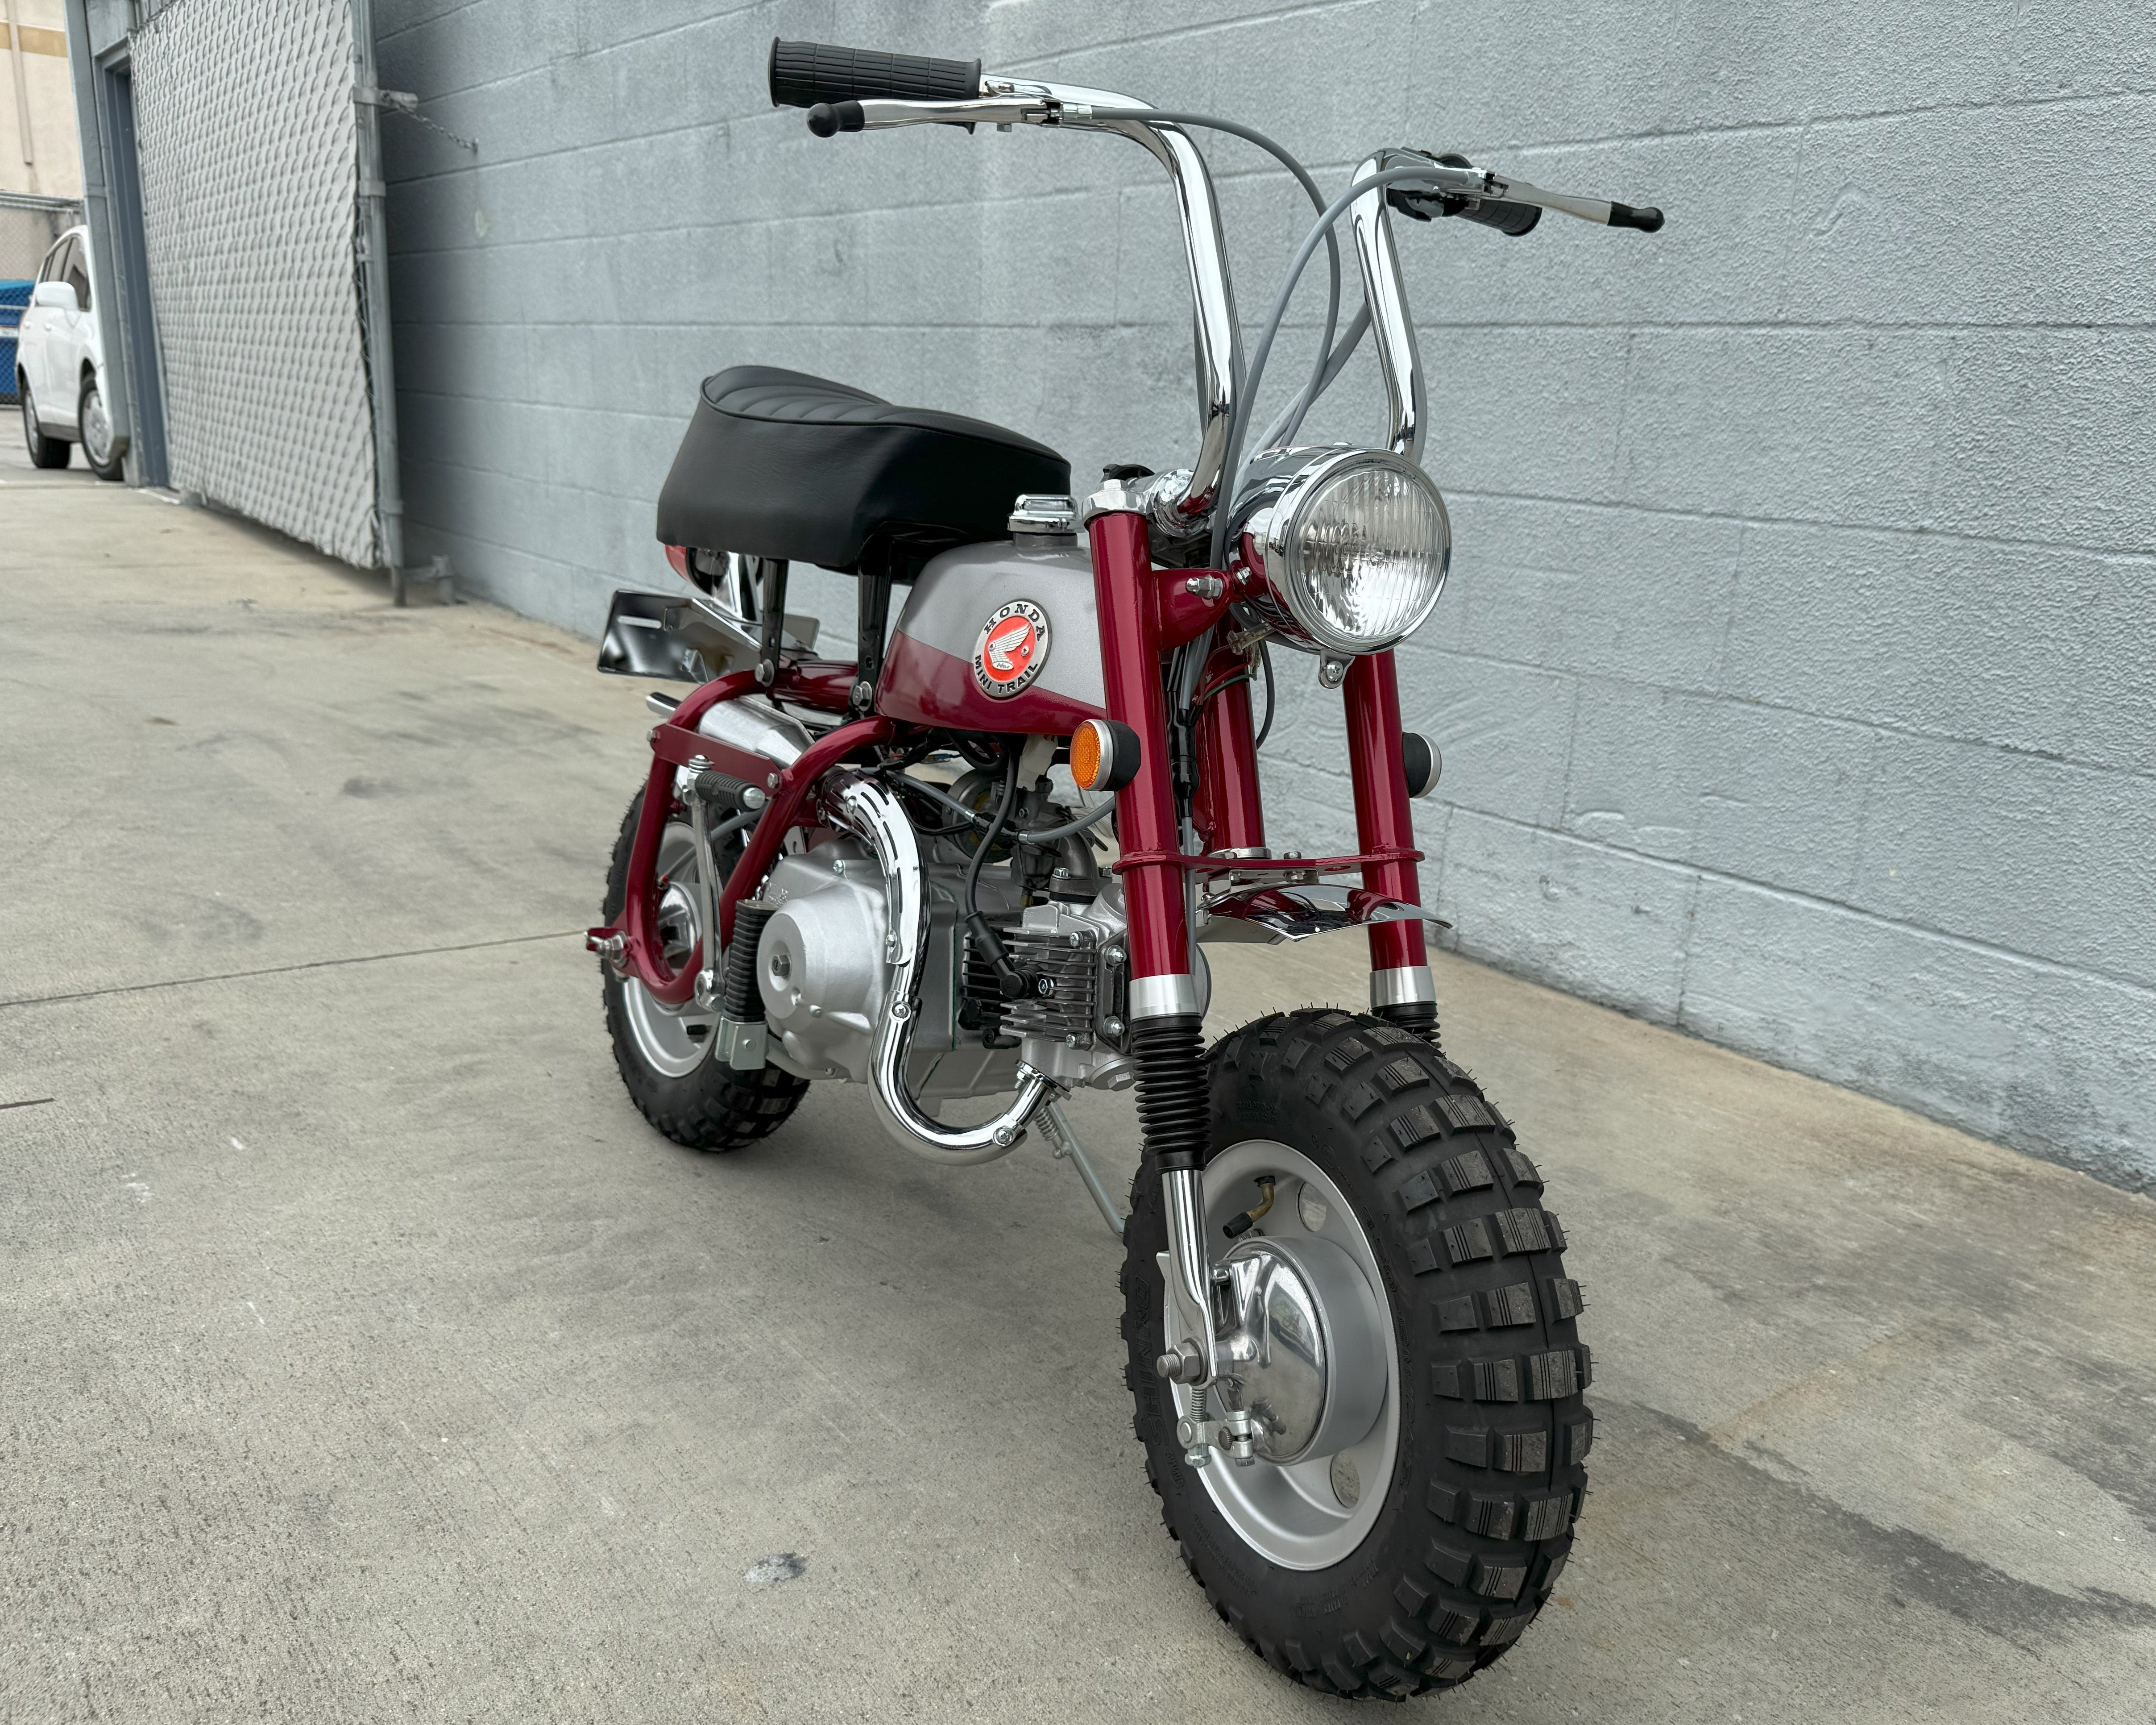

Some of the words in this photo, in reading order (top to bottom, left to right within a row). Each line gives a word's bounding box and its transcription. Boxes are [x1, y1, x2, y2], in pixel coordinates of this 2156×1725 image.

[984, 604, 1045, 641] HONDA
[975, 655, 992, 690] MINI
[997, 663, 1038, 694] TRAIL
[1135, 1275, 1169, 1446] SHINKO
